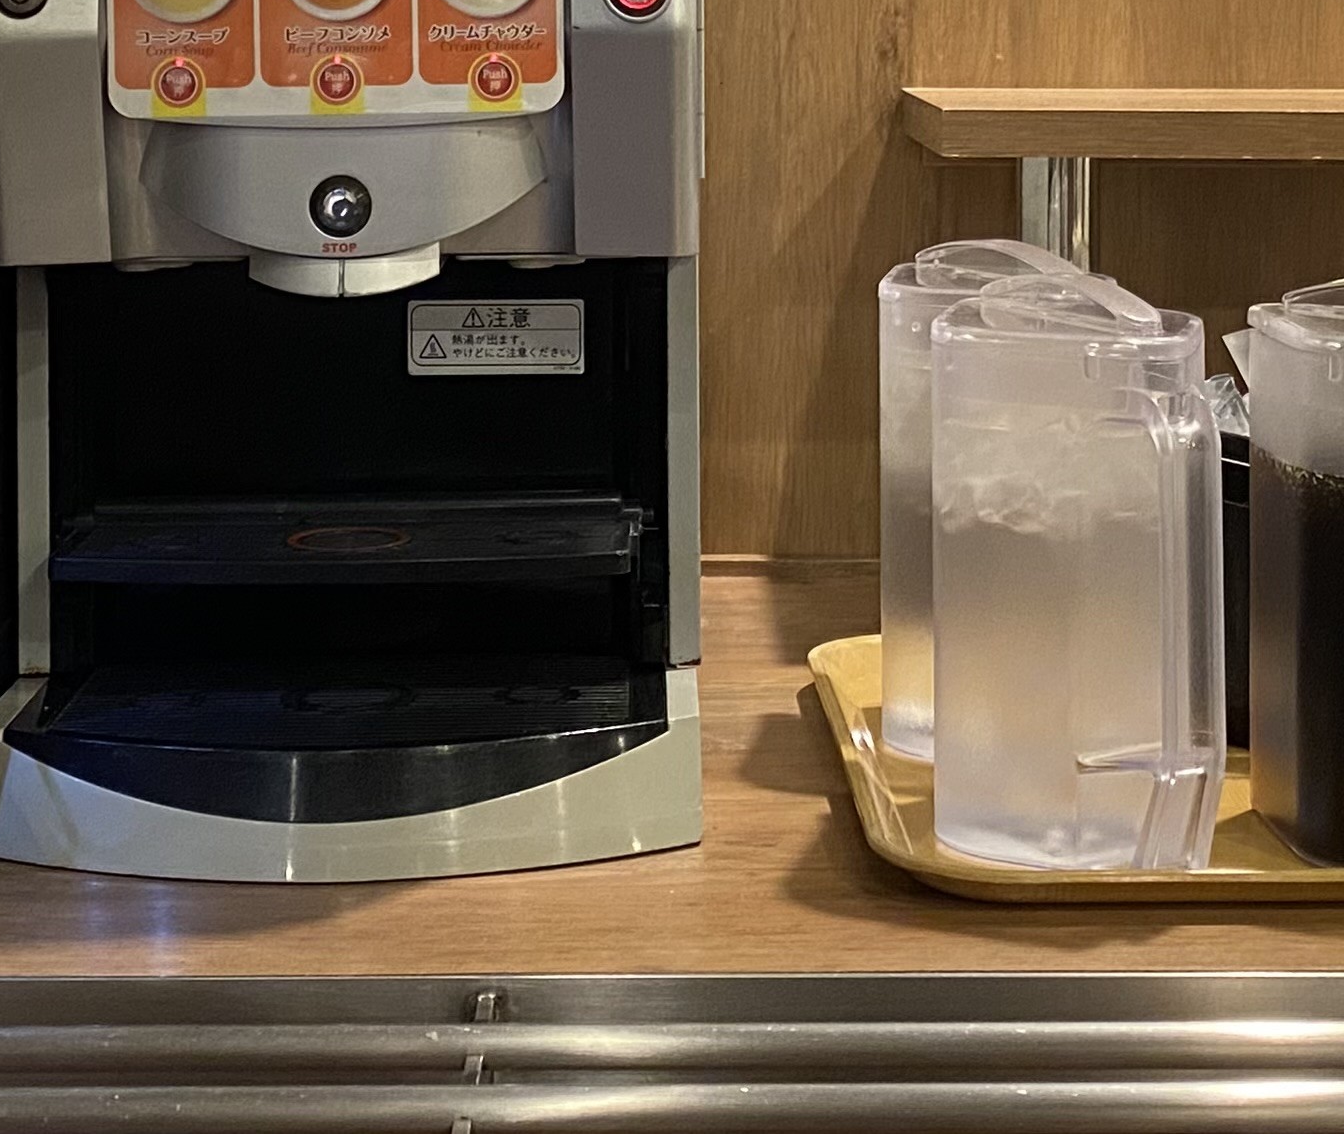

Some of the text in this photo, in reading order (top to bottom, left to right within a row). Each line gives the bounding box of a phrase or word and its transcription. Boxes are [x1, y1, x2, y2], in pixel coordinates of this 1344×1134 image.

[137, 27, 230, 45] コーンスープ
[284, 25, 392, 44] ビーフコンソメ
[428, 23, 547, 42] クリームチャウダー
[166, 73, 193, 84] Push
[324, 71, 350, 82] Push
[482, 68, 508, 79] Push
[321, 243, 357, 253] STOP
[486, 307, 531, 328] 注意
